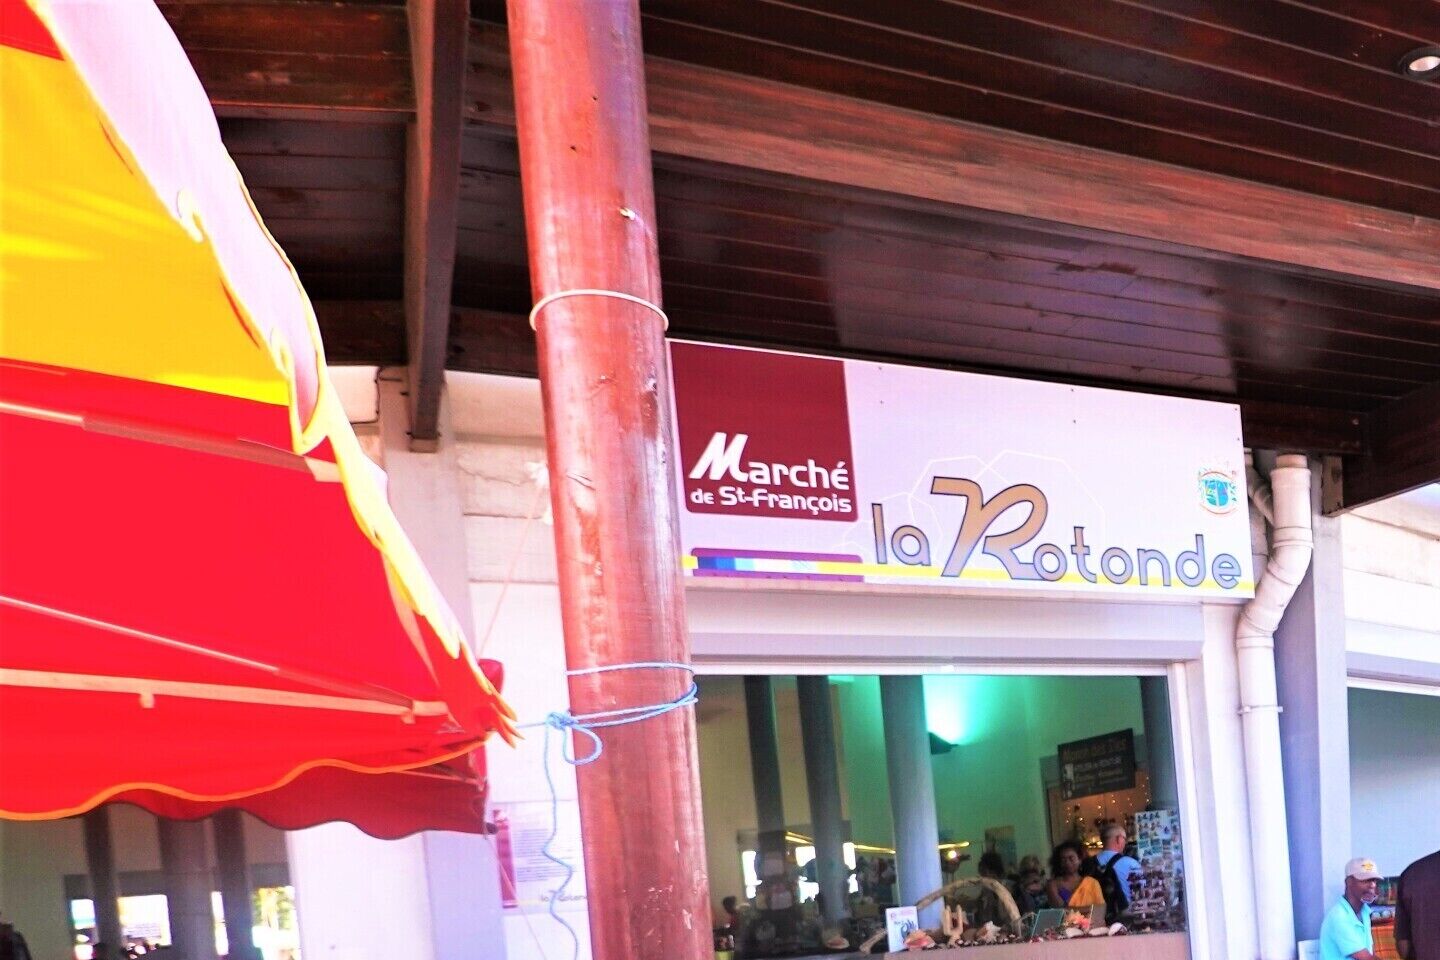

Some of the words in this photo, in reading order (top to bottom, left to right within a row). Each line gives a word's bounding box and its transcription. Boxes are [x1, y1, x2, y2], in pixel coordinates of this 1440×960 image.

[688, 431, 850, 491] Marché
[690, 488, 714, 505] de
[719, 485, 852, 515] St-François
[871, 502, 932, 566] la
[931, 476, 1243, 588] Rotonde
